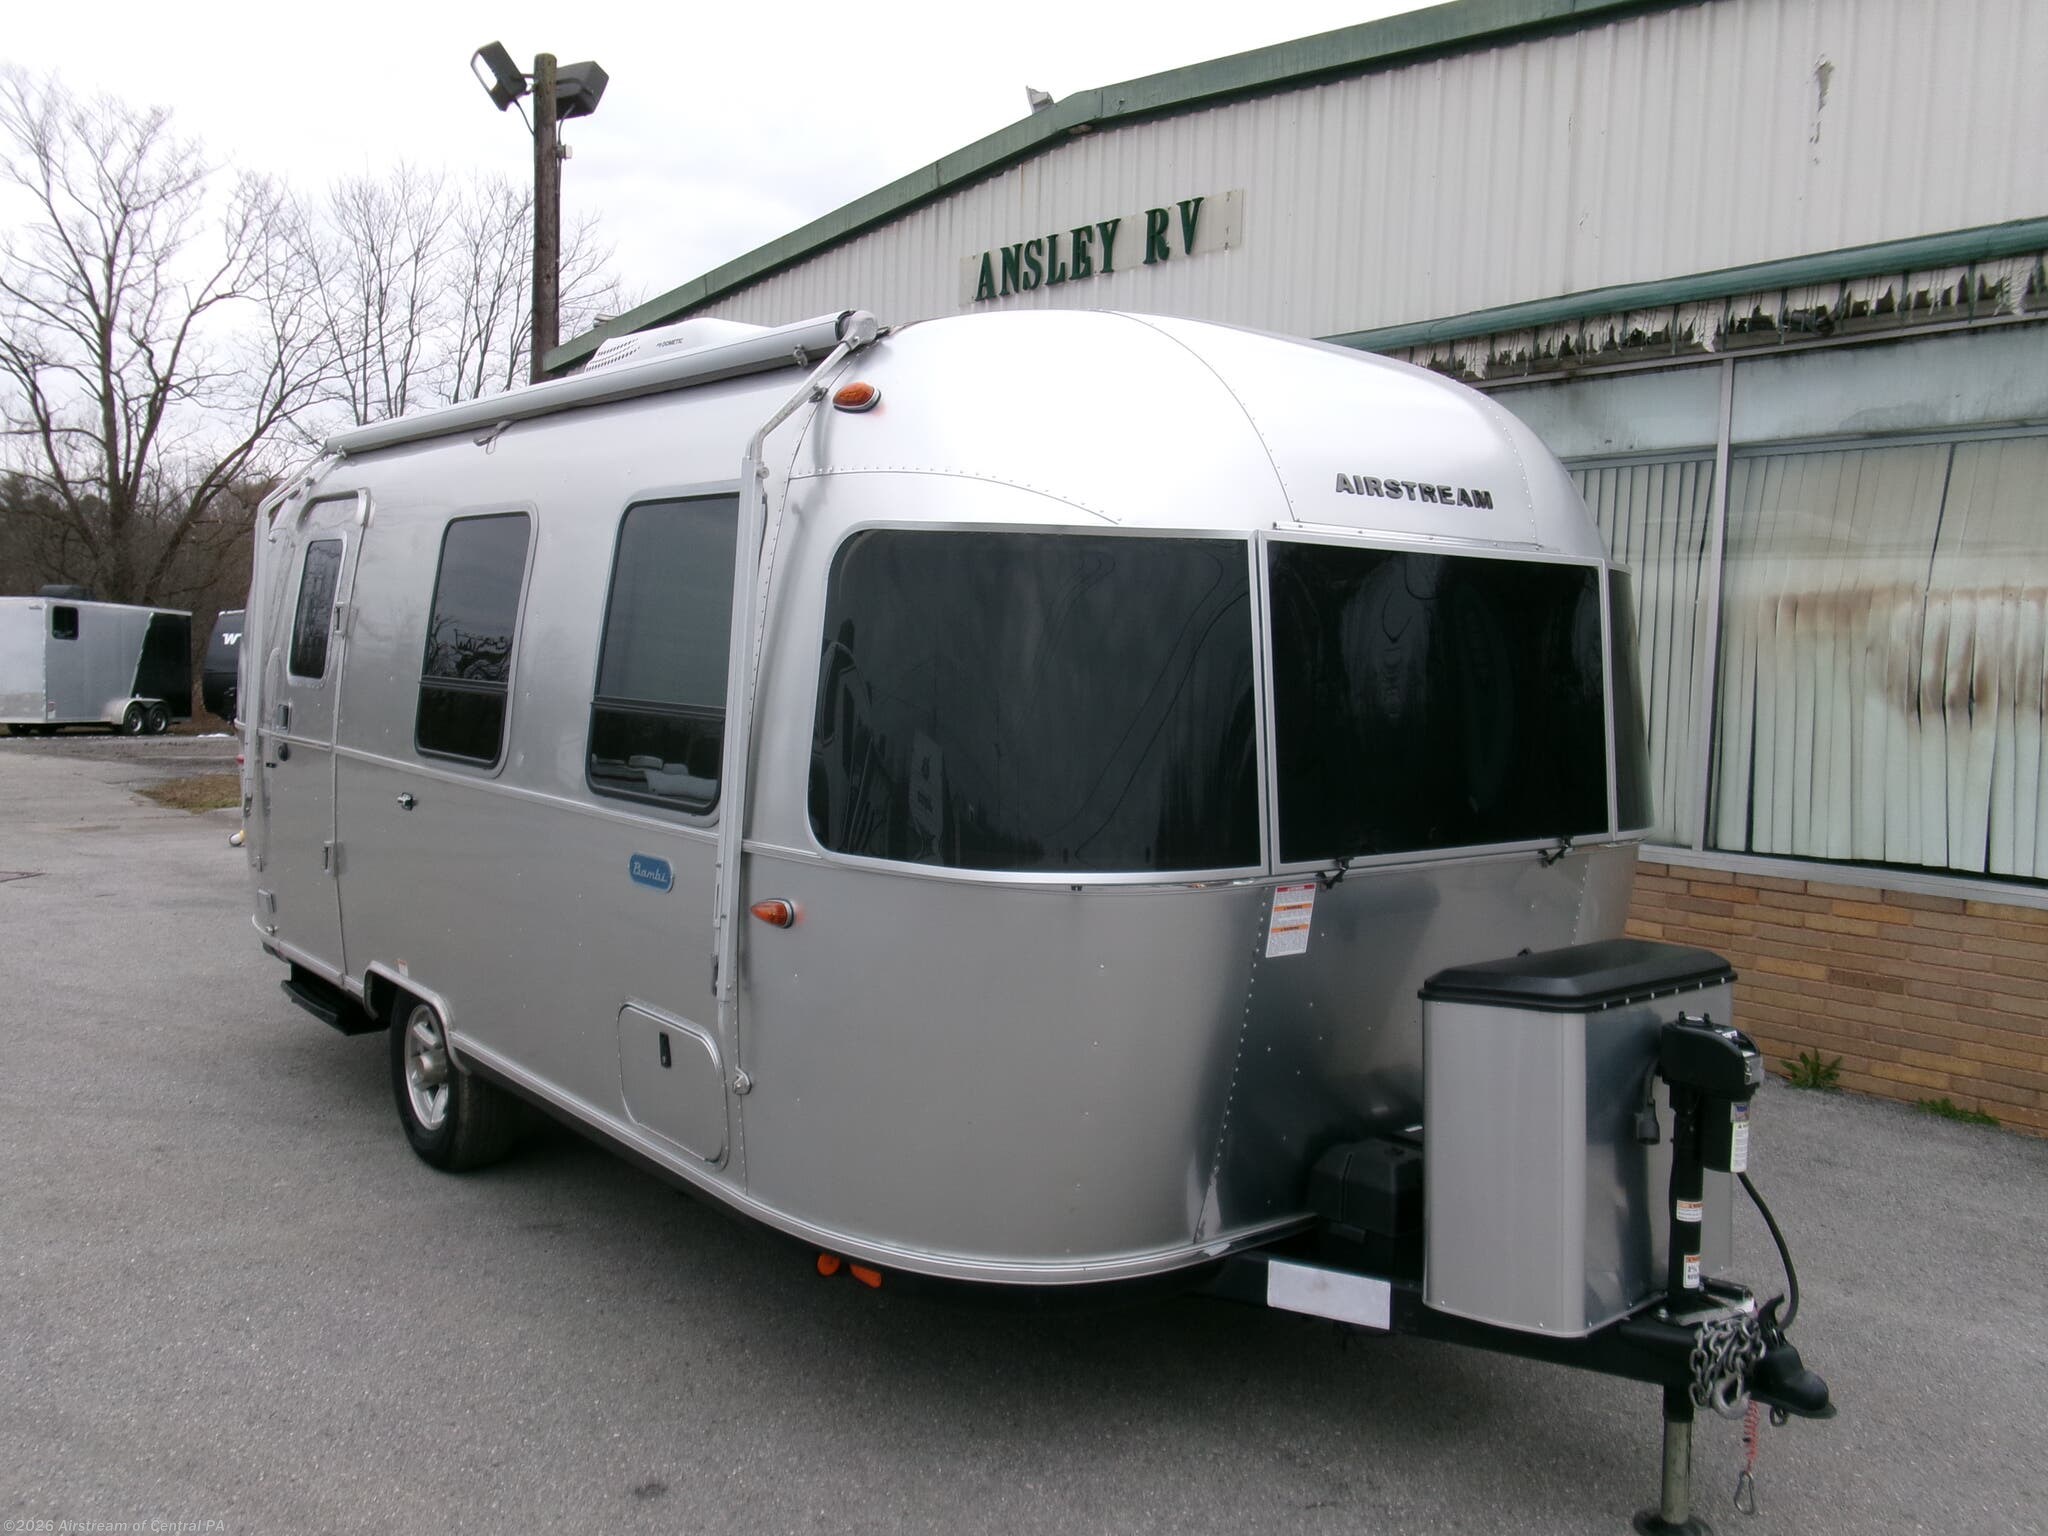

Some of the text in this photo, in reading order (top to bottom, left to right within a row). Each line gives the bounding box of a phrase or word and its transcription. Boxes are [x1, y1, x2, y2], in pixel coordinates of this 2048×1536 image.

[975, 197, 1204, 302] ANSLEY RV
[1335, 473, 1494, 510] AIRSTREAM
[632, 861, 668, 882] Bambi
